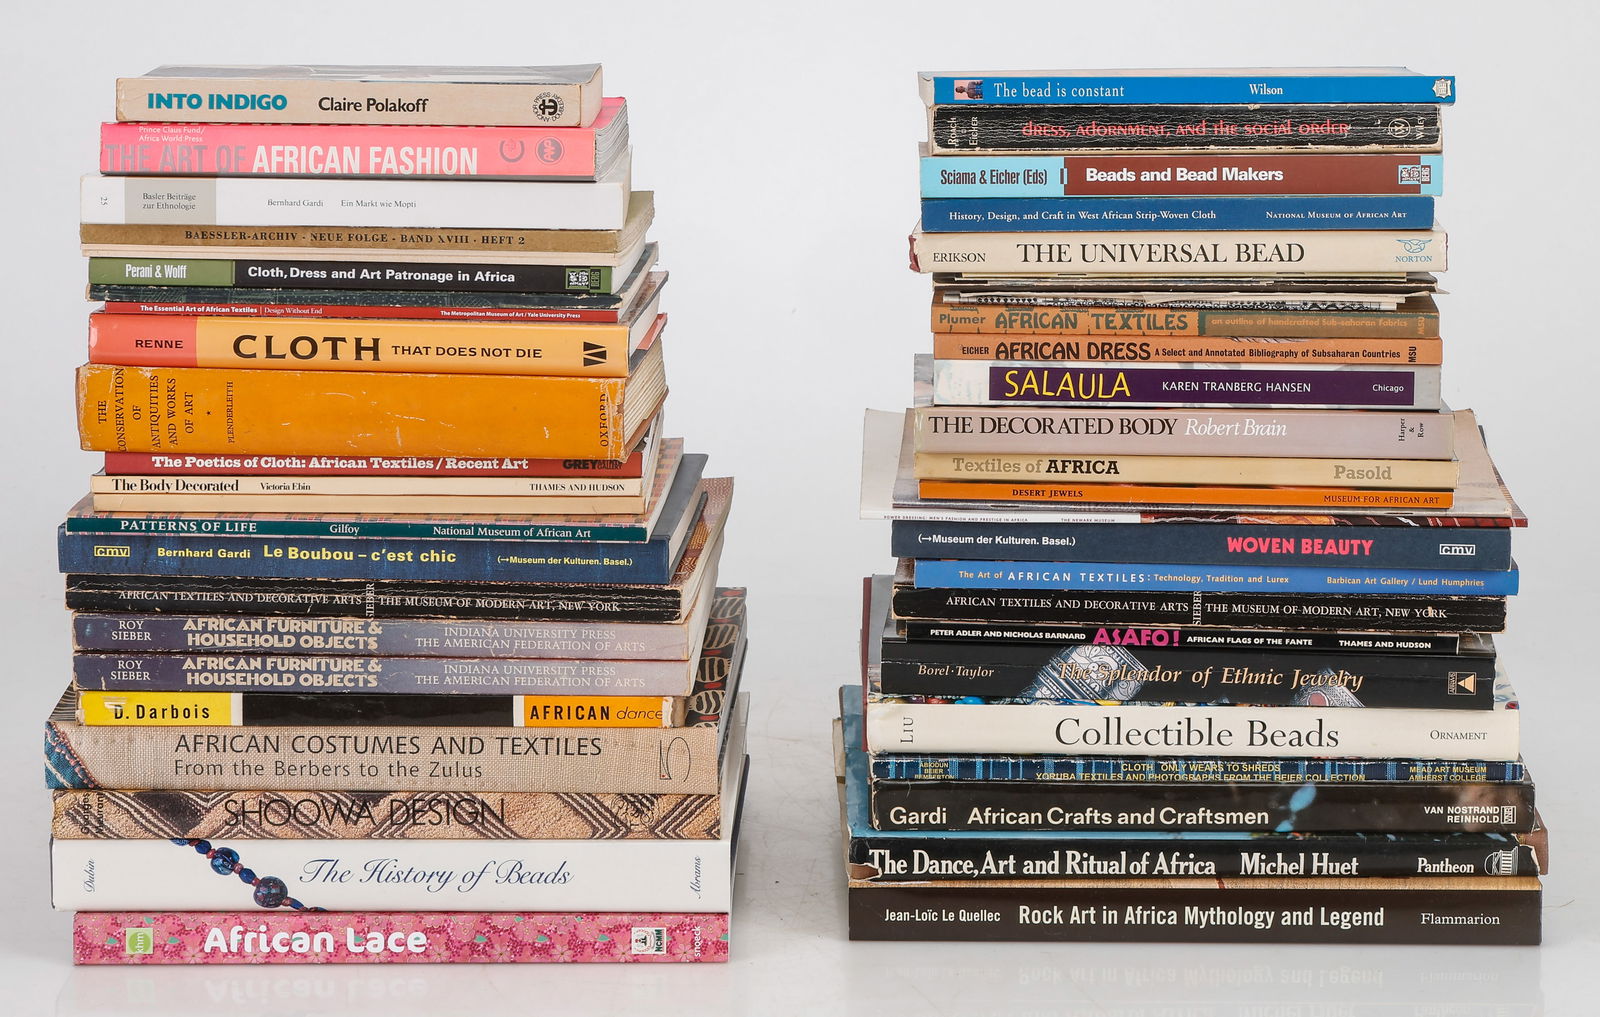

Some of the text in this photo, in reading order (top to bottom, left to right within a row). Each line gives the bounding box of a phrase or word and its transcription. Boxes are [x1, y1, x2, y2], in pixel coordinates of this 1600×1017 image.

[994, 81, 1125, 97] The bead is constant
[1249, 84, 1283, 95] Wilson
[148, 94, 288, 111] INTO INDIGO
[318, 97, 428, 113] Claire Polakoff
[104, 144, 478, 175] THE ART OF AFRICAN FASHION
[940, 170, 1047, 186] Sciama & Eicher (Eds)
[1086, 168, 1283, 182] Beads and Bead Makers
[142, 193, 196, 202] Basler Beiträge
[157, 202, 196, 211] Ethnologie
[933, 252, 986, 263] ERIKSON
[1017, 243, 1305, 263] THE UNIVERSAL BEAD
[125, 264, 187, 279] Perani & Wolff
[939, 314, 986, 325] Plumer
[995, 312, 1188, 331] AFRICAN TEXTILES
[135, 339, 183, 349] RENNE
[232, 334, 542, 362] CLOTH THAT DOES NOT DIE
[962, 346, 989, 355] EICHER
[995, 342, 1150, 360] AFRICAN DRESS
[1408, 346, 1417, 363] MSU
[1005, 369, 1131, 400] SALAULA
[1162, 381, 1311, 392] KAREN TRANBERG HANSEN
[1372, 383, 1404, 394] Chicago
[167, 378, 176, 419] WORKS
[150, 376, 161, 448] ANTIQUITIES
[185, 392, 194, 434] OF ART
[226, 381, 234, 443] PLENDERLEITH
[600, 393, 608, 447] OXFORD
[928, 416, 1287, 436] THE DECORATED BODY Robert Brain
[953, 458, 1119, 474] Textiles of AFRICA
[1334, 465, 1392, 480] Pasold
[112, 478, 239, 493] The Body Decorated
[260, 483, 311, 491] Victoria Ebin
[530, 483, 566, 491] THAMES
[589, 484, 624, 492] HUDSON
[121, 520, 257, 532] PATTERNS OF LIFE
[330, 523, 360, 535] Gilfoy
[97, 547, 128, 556] cmv
[157, 548, 251, 559] Bernhard Gardi
[1227, 536, 1373, 555] WOVEN BEAUTY
[1442, 545, 1473, 555] cmv
[119, 620, 144, 629] ROY
[183, 618, 382, 635] AFRICAN FURNITURE &
[111, 631, 152, 641] SIEBER
[188, 634, 378, 650] HOUSEHOLD OBJECTS
[114, 705, 210, 719] D. Darbois
[530, 705, 609, 720] AFRICAN
[1055, 716, 1339, 748] Collectible Beads
[175, 734, 602, 756] AFRICAN COSTUMES AND TEXTILES
[224, 798, 505, 827] SHOOWA DESIGN
[890, 806, 947, 825] Gardi
[968, 806, 1268, 826] African Crafts and Craftsmen
[1447, 806, 1500, 814] NOSTRAND
[1447, 815, 1500, 823] REINHOLD
[1240, 852, 1358, 876] Michel Huet
[1417, 858, 1474, 873] Pantheon
[84, 859, 95, 892] Dubin
[299, 858, 574, 893] The History of Beads
[690, 856, 702, 899] Abrams
[884, 908, 1001, 922] Jean-Loïc Le Quellec
[1421, 913, 1500, 925] Flammarion
[204, 925, 428, 953] African Lace
[692, 926, 700, 957] snoeck
